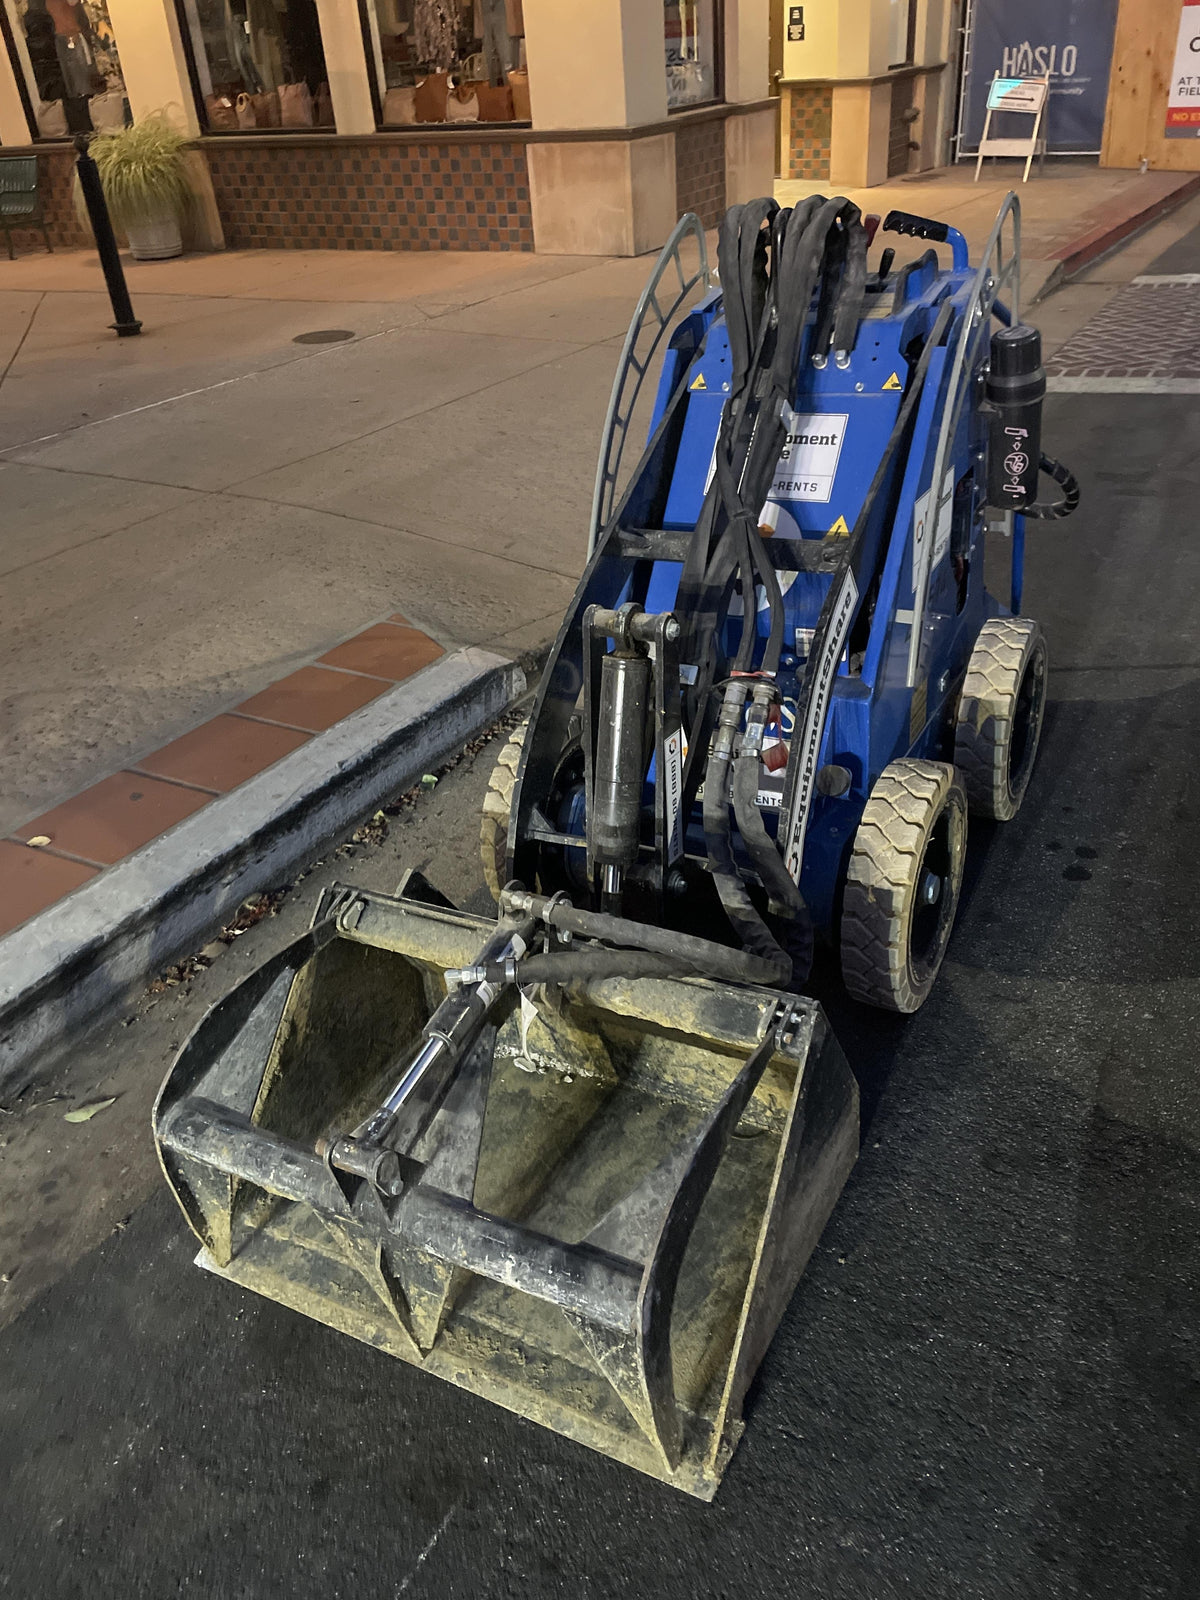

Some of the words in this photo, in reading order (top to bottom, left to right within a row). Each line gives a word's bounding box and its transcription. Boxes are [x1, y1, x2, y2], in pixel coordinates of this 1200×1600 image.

[1002, 41, 1077, 77] HASLO
[1177, 77, 1193, 86] AT
[792, 591, 853, 846] EquipmentShare
